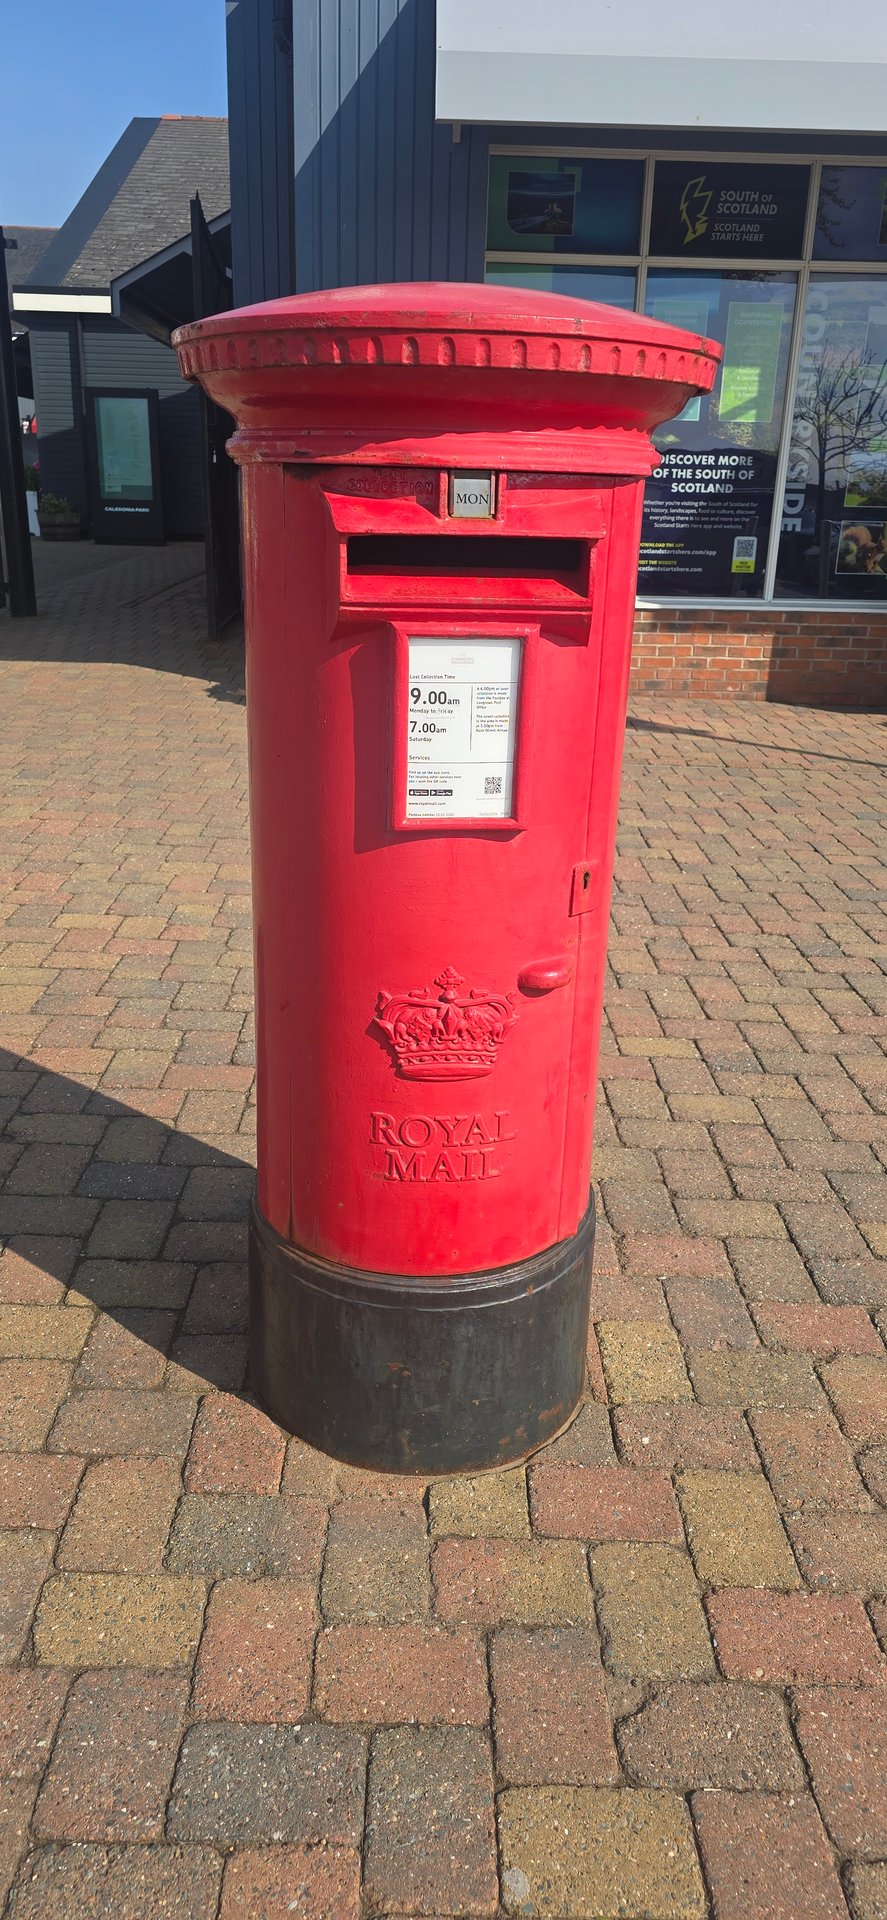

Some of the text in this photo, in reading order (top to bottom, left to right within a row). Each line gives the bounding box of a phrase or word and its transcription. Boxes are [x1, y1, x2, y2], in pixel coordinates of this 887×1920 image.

[720, 190, 773, 202] SOUTH OF
[716, 203, 778, 215] SCOTLAND
[714, 223, 760, 232] SCOTLAND
[710, 232, 764, 242] STARTS HERE
[718, 455, 754, 466] MORE
[652, 468, 754, 480] OF THE SOUTH OF
[348, 478, 434, 495] COLLECTION
[671, 482, 734, 493] SCOTLAND
[456, 493, 489, 504] MON
[410, 687, 460, 705] 9.00am
[410, 721, 447, 733] 7.00am
[369, 1111, 518, 1148] ROYAL
[384, 1148, 503, 1182] MAIL
